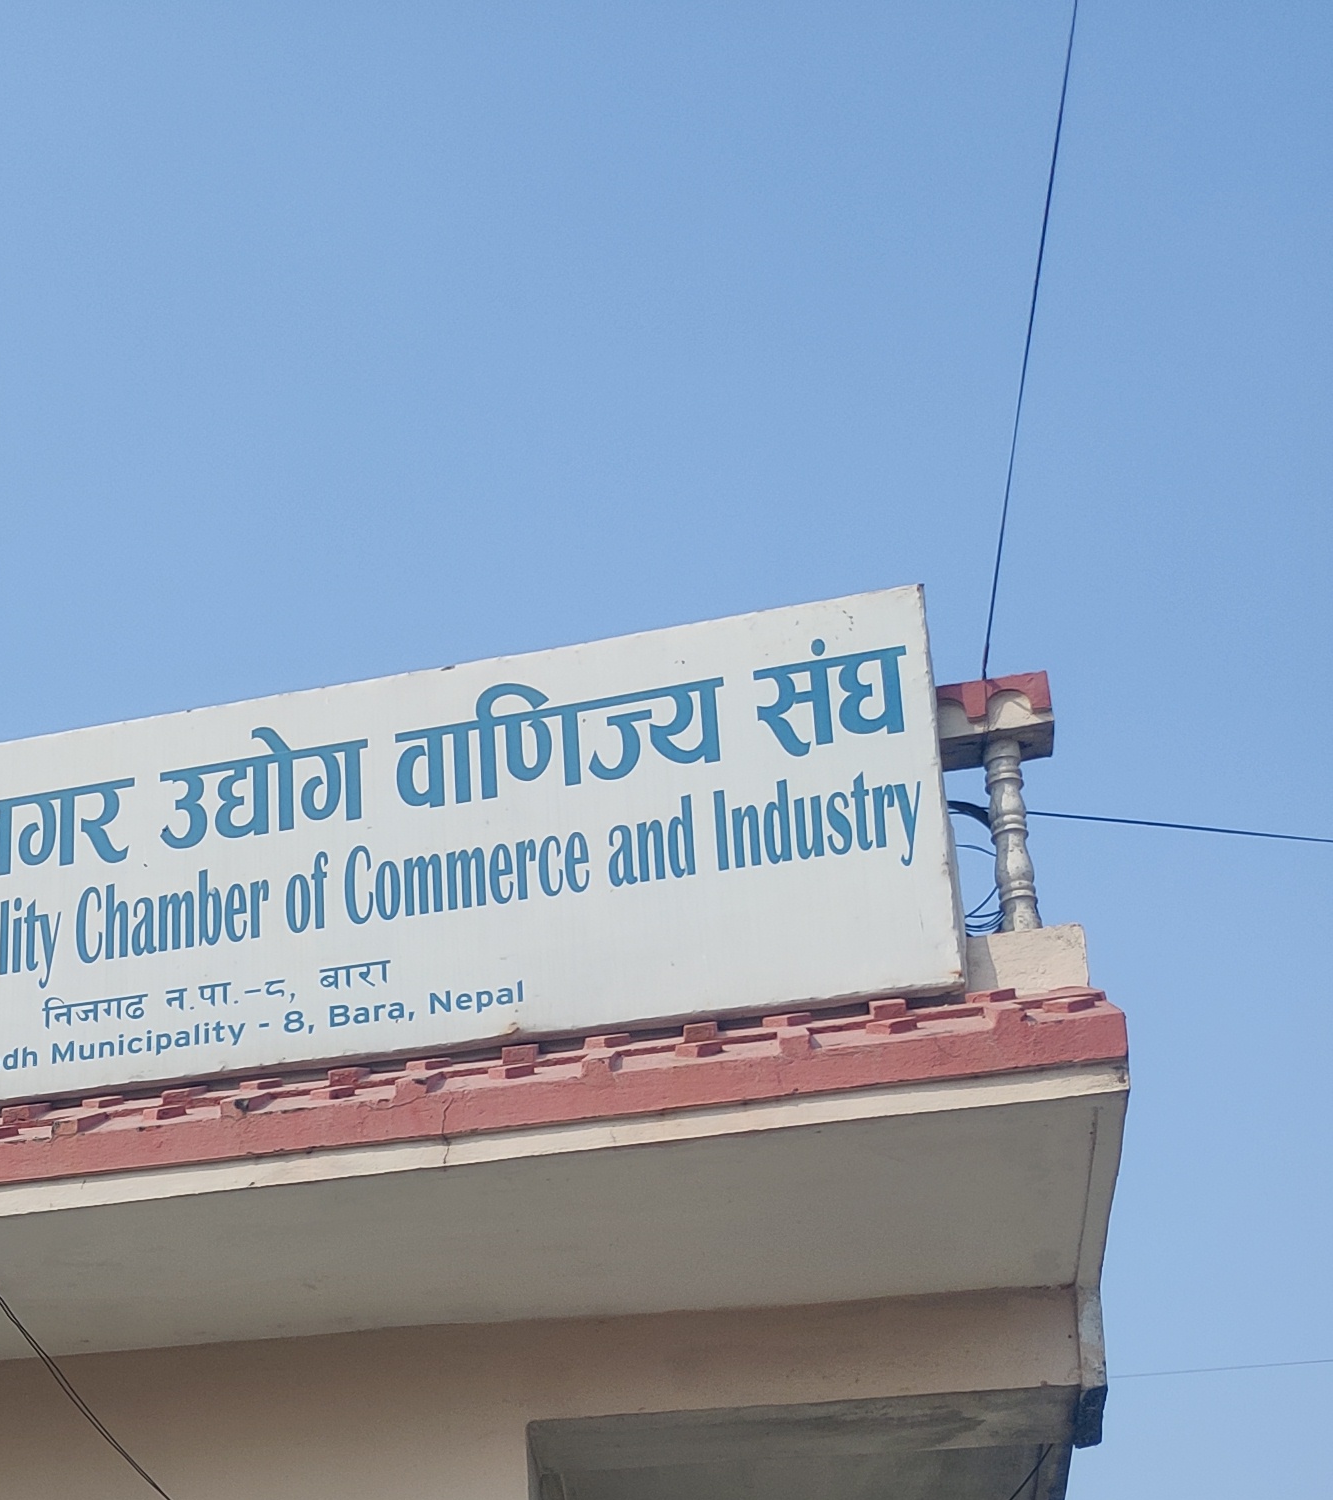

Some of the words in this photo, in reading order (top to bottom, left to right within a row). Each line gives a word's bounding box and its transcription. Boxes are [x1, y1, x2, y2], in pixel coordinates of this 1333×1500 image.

[160, 726, 368, 849] उद्योग
[395, 682, 724, 809] वाणिज्य
[754, 638, 907, 757] संघ
[75, 869, 269, 964] Chamber
[285, 851, 328, 934] of
[345, 828, 589, 925] Commerce
[608, 794, 696, 887] and
[714, 771, 921, 871] Industry
[42, 993, 148, 1030] निजगढ
[319, 959, 391, 990] बारा
[51, 1020, 246, 1065] Municipality
[283, 1011, 315, 1035] 8,
[328, 998, 415, 1028] Bara,
[429, 980, 525, 1015] Nepal
